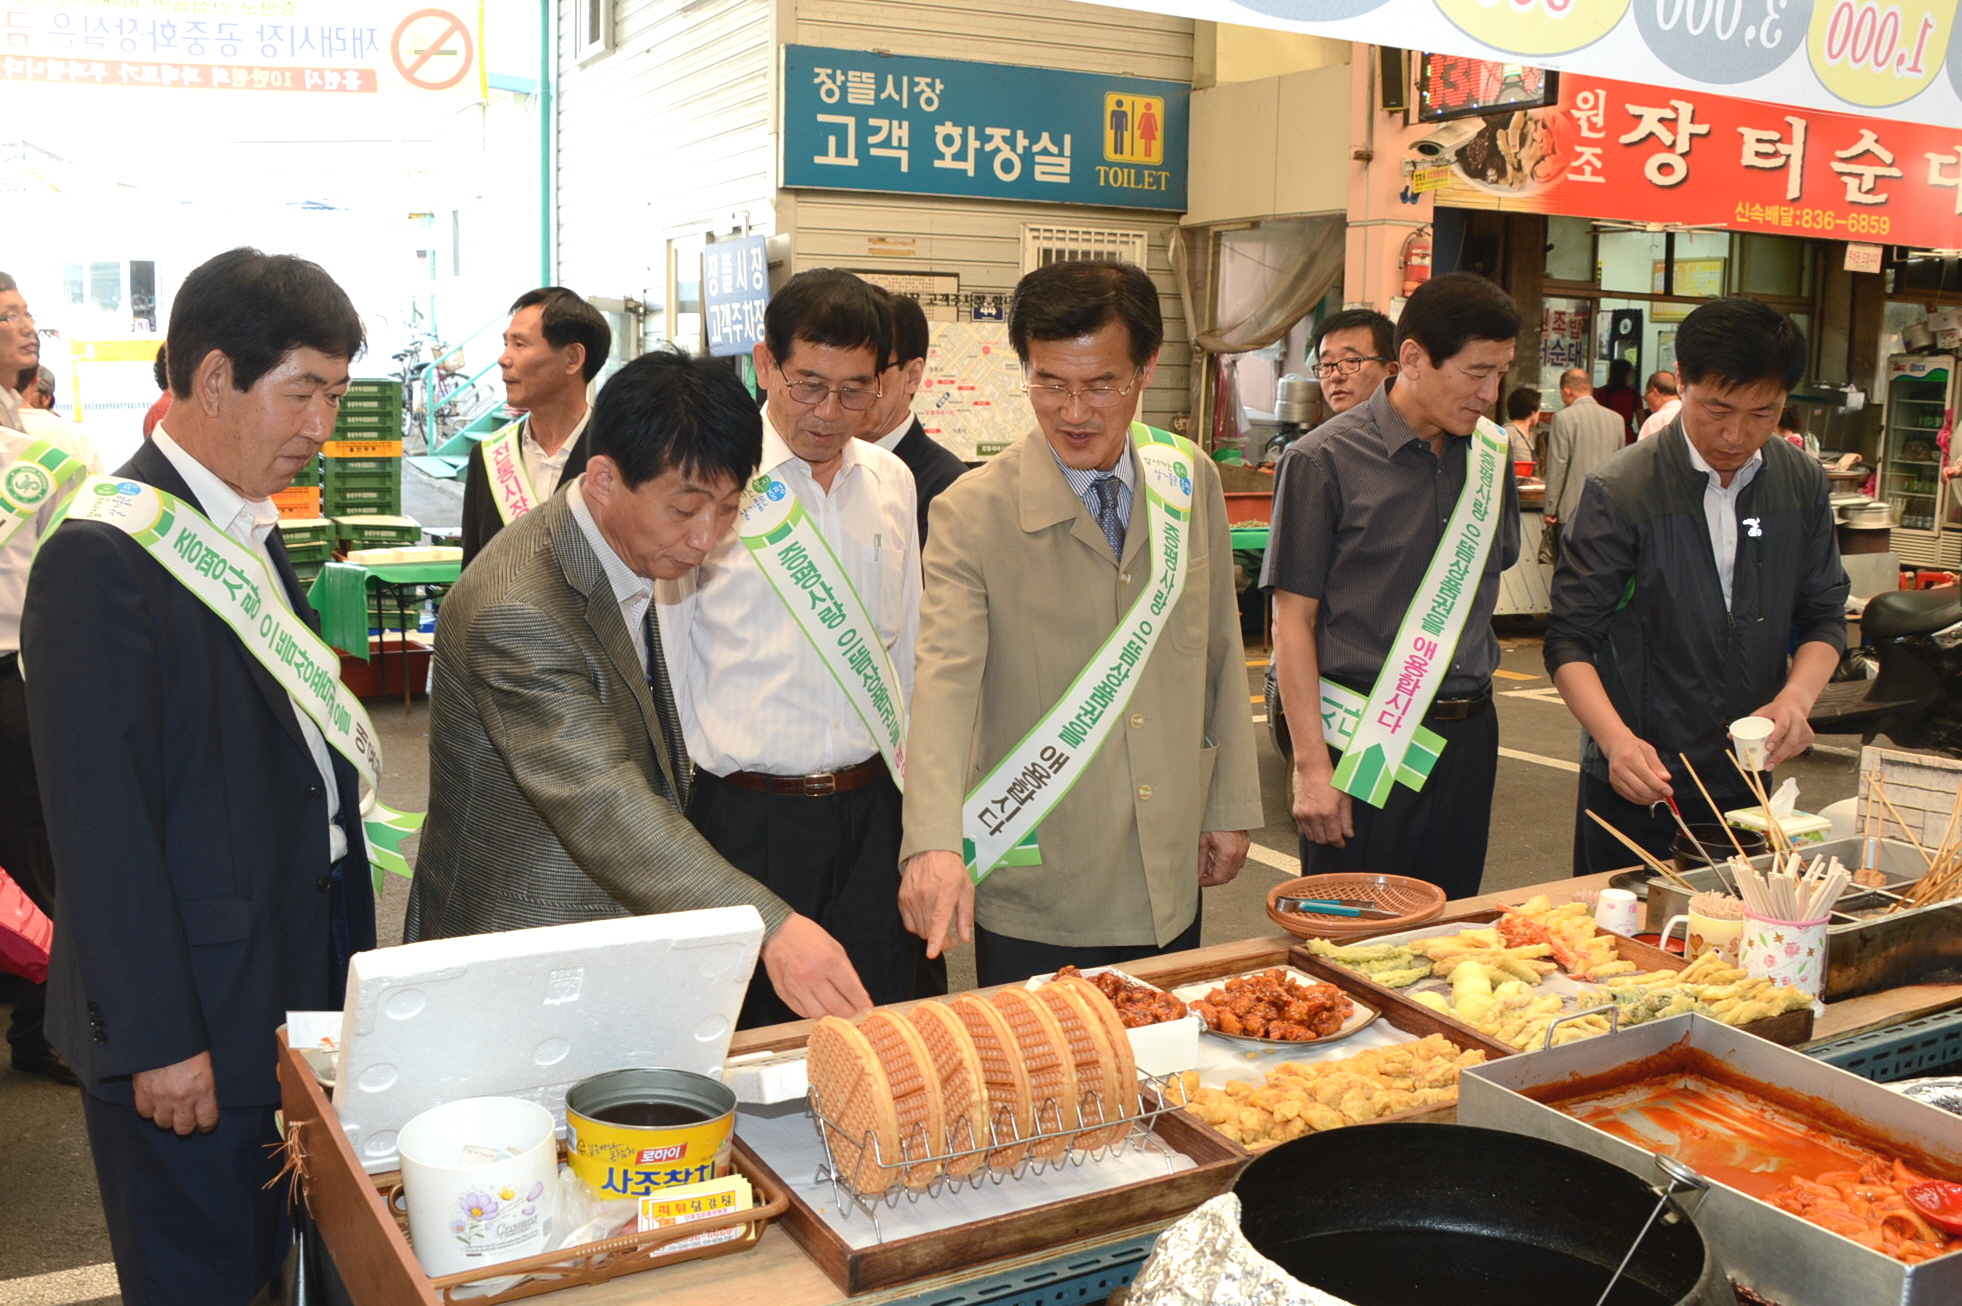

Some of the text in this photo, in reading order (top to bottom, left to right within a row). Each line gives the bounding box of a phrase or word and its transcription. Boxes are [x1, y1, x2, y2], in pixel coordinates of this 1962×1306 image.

[813, 67, 944, 112] 장뜰시장
[813, 113, 1072, 183] 고객 화장실
[1566, 89, 1606, 183] 원조
[1096, 166, 1170, 191] TOILET
[1734, 200, 1890, 235] 신속배달:836-6859
[707, 247, 763, 297] 장뜰시장
[710, 299, 765, 344] 고객주차장
[980, 307, 997, 317] 44
[492, 441, 530, 519] 전통시장
[768, 483, 786, 500] 증평
[172, 526, 262, 621] 증평사랑
[1376, 448, 1497, 735] 증평사랑 으뜸상품권을 애용합시다
[777, 541, 901, 749] 증평사랑 으뜸상품권을
[977, 520, 1181, 837] 증평사랑 으뜸상품권을 애용합시다
[601, 1160, 716, 1196] 사조참치
[641, 1146, 681, 1163] 로하이
